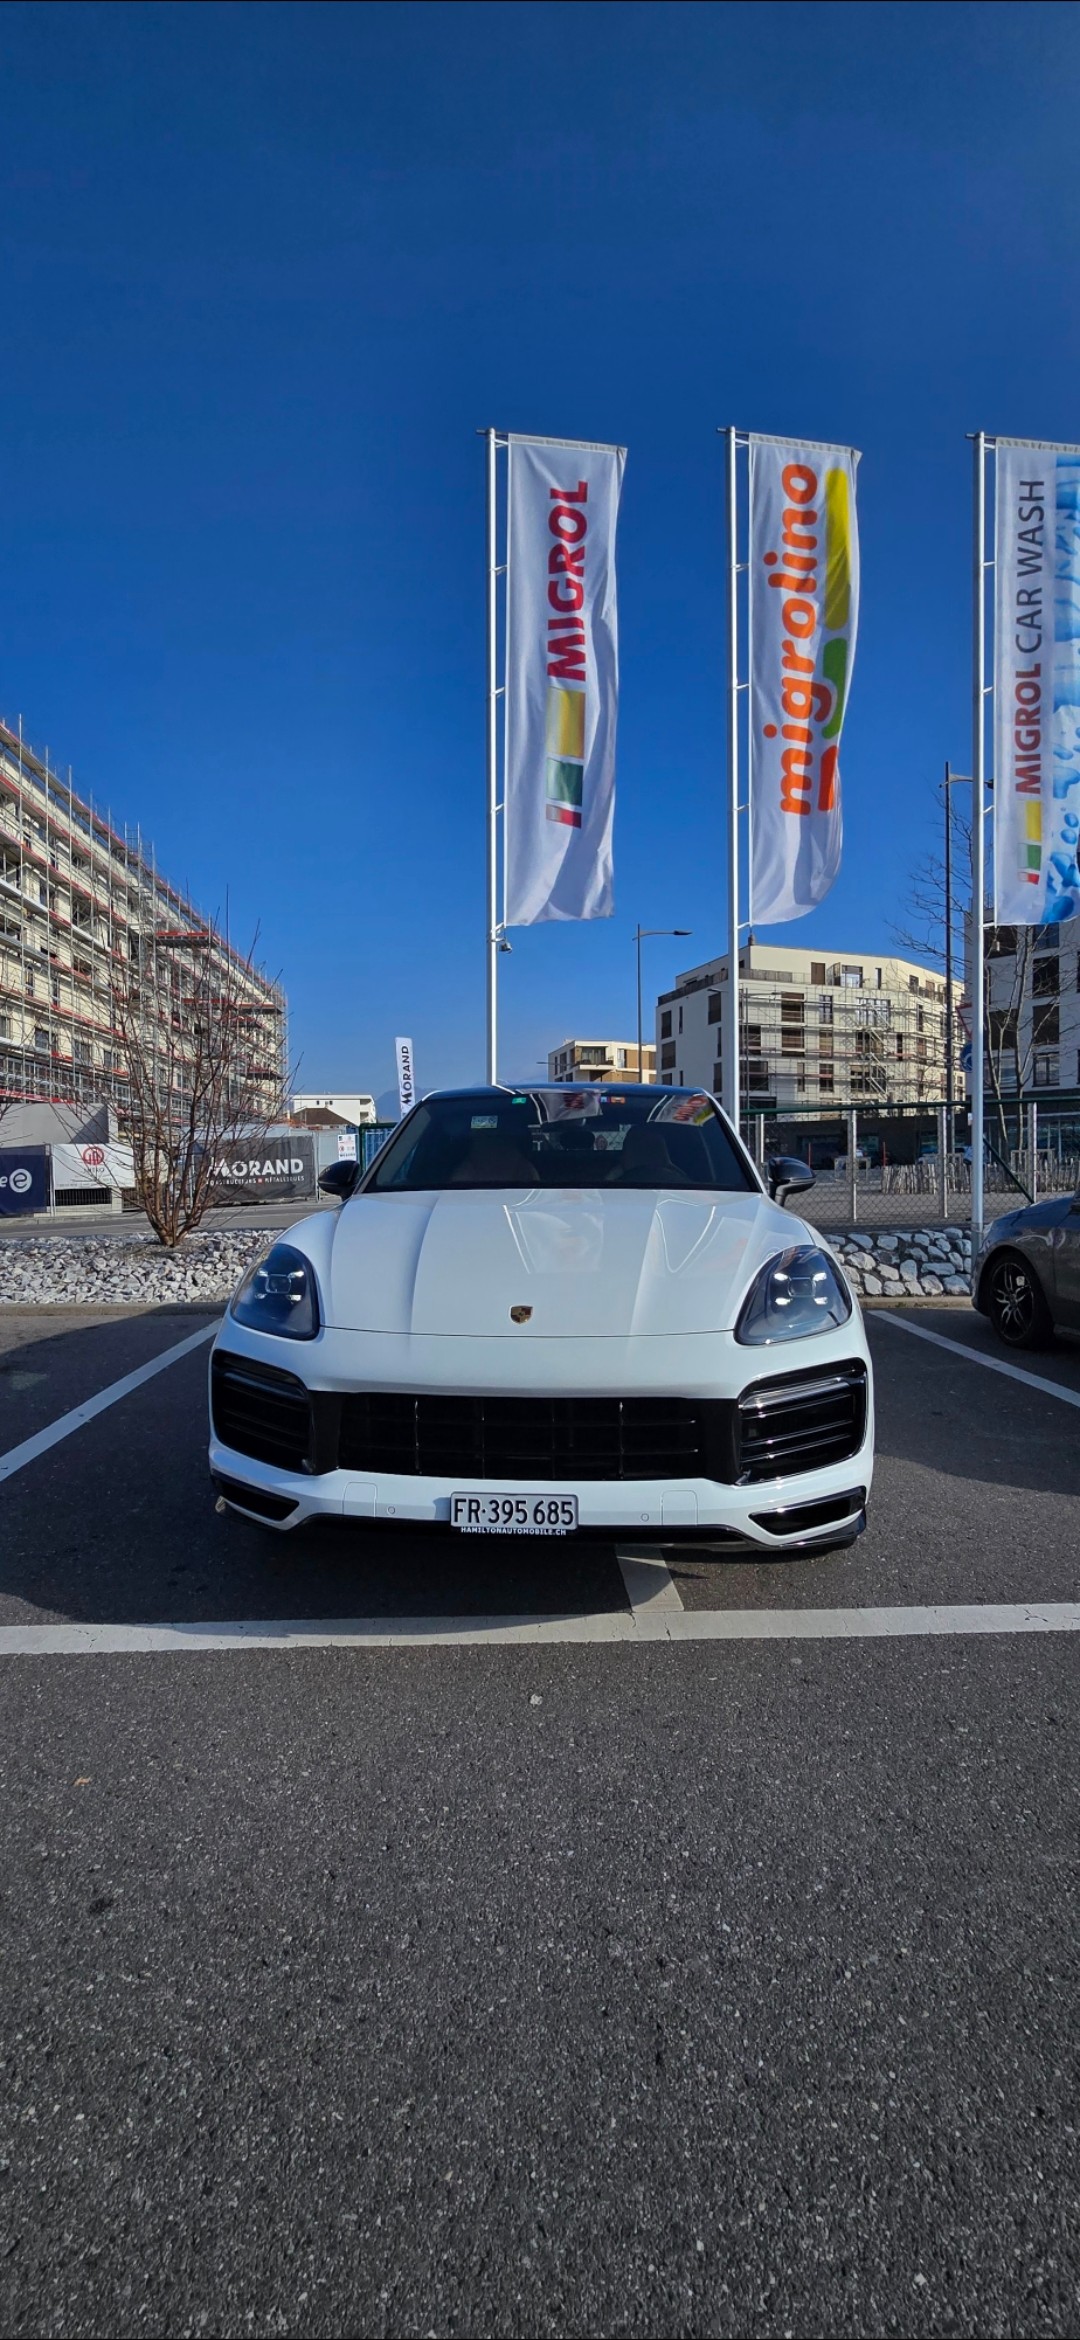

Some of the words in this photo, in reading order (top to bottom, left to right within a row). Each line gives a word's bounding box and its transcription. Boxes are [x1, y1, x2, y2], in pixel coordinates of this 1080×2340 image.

[1016, 480, 1045, 578] WASH
[547, 480, 588, 682] MIGROL
[763, 463, 833, 816] migrolino
[1015, 587, 1043, 654] CAR
[1014, 662, 1042, 795] MIGROL
[401, 1045, 413, 1106] MORAND
[206, 1156, 304, 1177] MORAND
[460, 1526, 567, 1536] HAMILTONAUTOMOBILE.CH
[532, 1499, 574, 1526] 685
